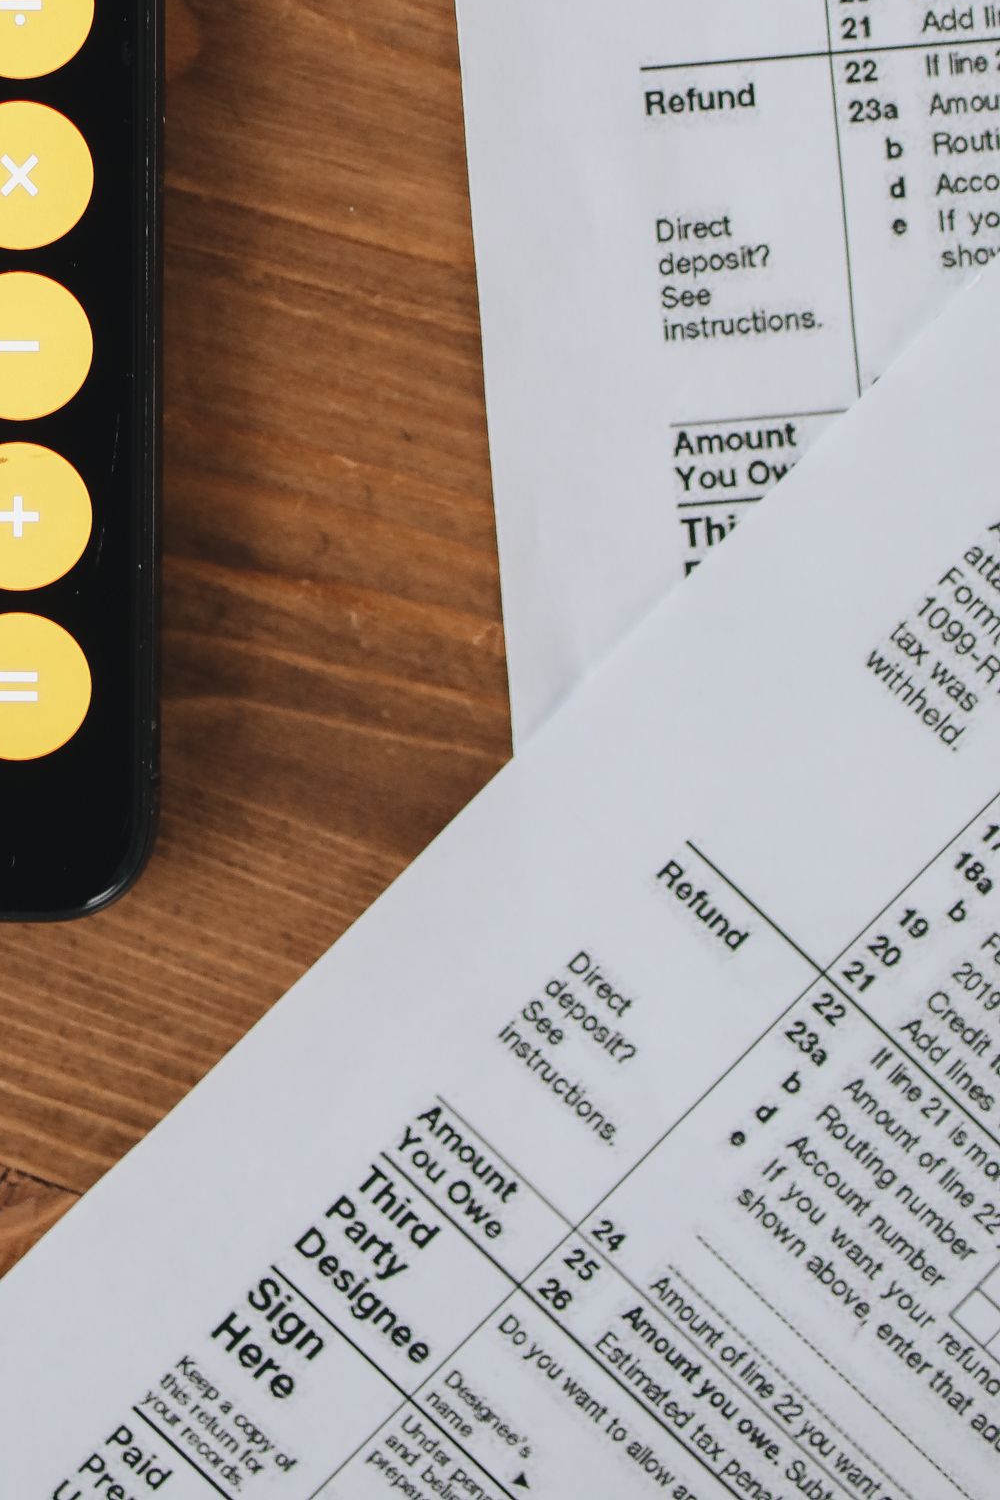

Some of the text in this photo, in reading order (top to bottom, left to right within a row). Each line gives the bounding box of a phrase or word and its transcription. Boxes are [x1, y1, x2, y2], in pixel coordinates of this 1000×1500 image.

[840, 7, 974, 40] 21 Add
[644, 82, 756, 116] Refund
[844, 59, 879, 84] 22
[848, 98, 899, 124] 23a
[655, 215, 732, 243] Direct
[658, 244, 770, 278] deposit?
[661, 285, 712, 310] See
[663, 309, 823, 342] instructions.
[673, 422, 797, 458] Amount
[674, 465, 737, 492] You
[656, 859, 750, 952] Refund
[566, 950, 633, 1018] Direct
[811, 992, 847, 1027] 22
[841, 960, 876, 992] 21
[521, 1000, 564, 1046] See
[544, 980, 637, 1064] deposit?
[784, 1020, 828, 1068] 23a
[497, 1021, 617, 1146] instructions.
[397, 1125, 503, 1239] You Owe
[416, 1106, 518, 1204] Amount
[815, 1104, 978, 1261] Routing number
[324, 1194, 409, 1281] Party
[358, 1163, 442, 1250] Third
[591, 1220, 627, 1252] 24
[785, 1136, 946, 1287] Account number
[762, 1158, 936, 1328] If you want your
[247, 1277, 325, 1361] Sign
[293, 1226, 430, 1364] Designee
[536, 1278, 573, 1311] 26
[736, 1188, 974, 1417] shown above, enter that
[210, 1311, 296, 1399] Here
[562, 1248, 780, 1466] 25 Amount you owe.
[426, 1391, 473, 1437] name
[444, 1370, 532, 1459] Designee's
[497, 1313, 676, 1487] Do you want to allow
[593, 1331, 725, 1463] Estimated tax
[104, 1424, 174, 1491] Paid
